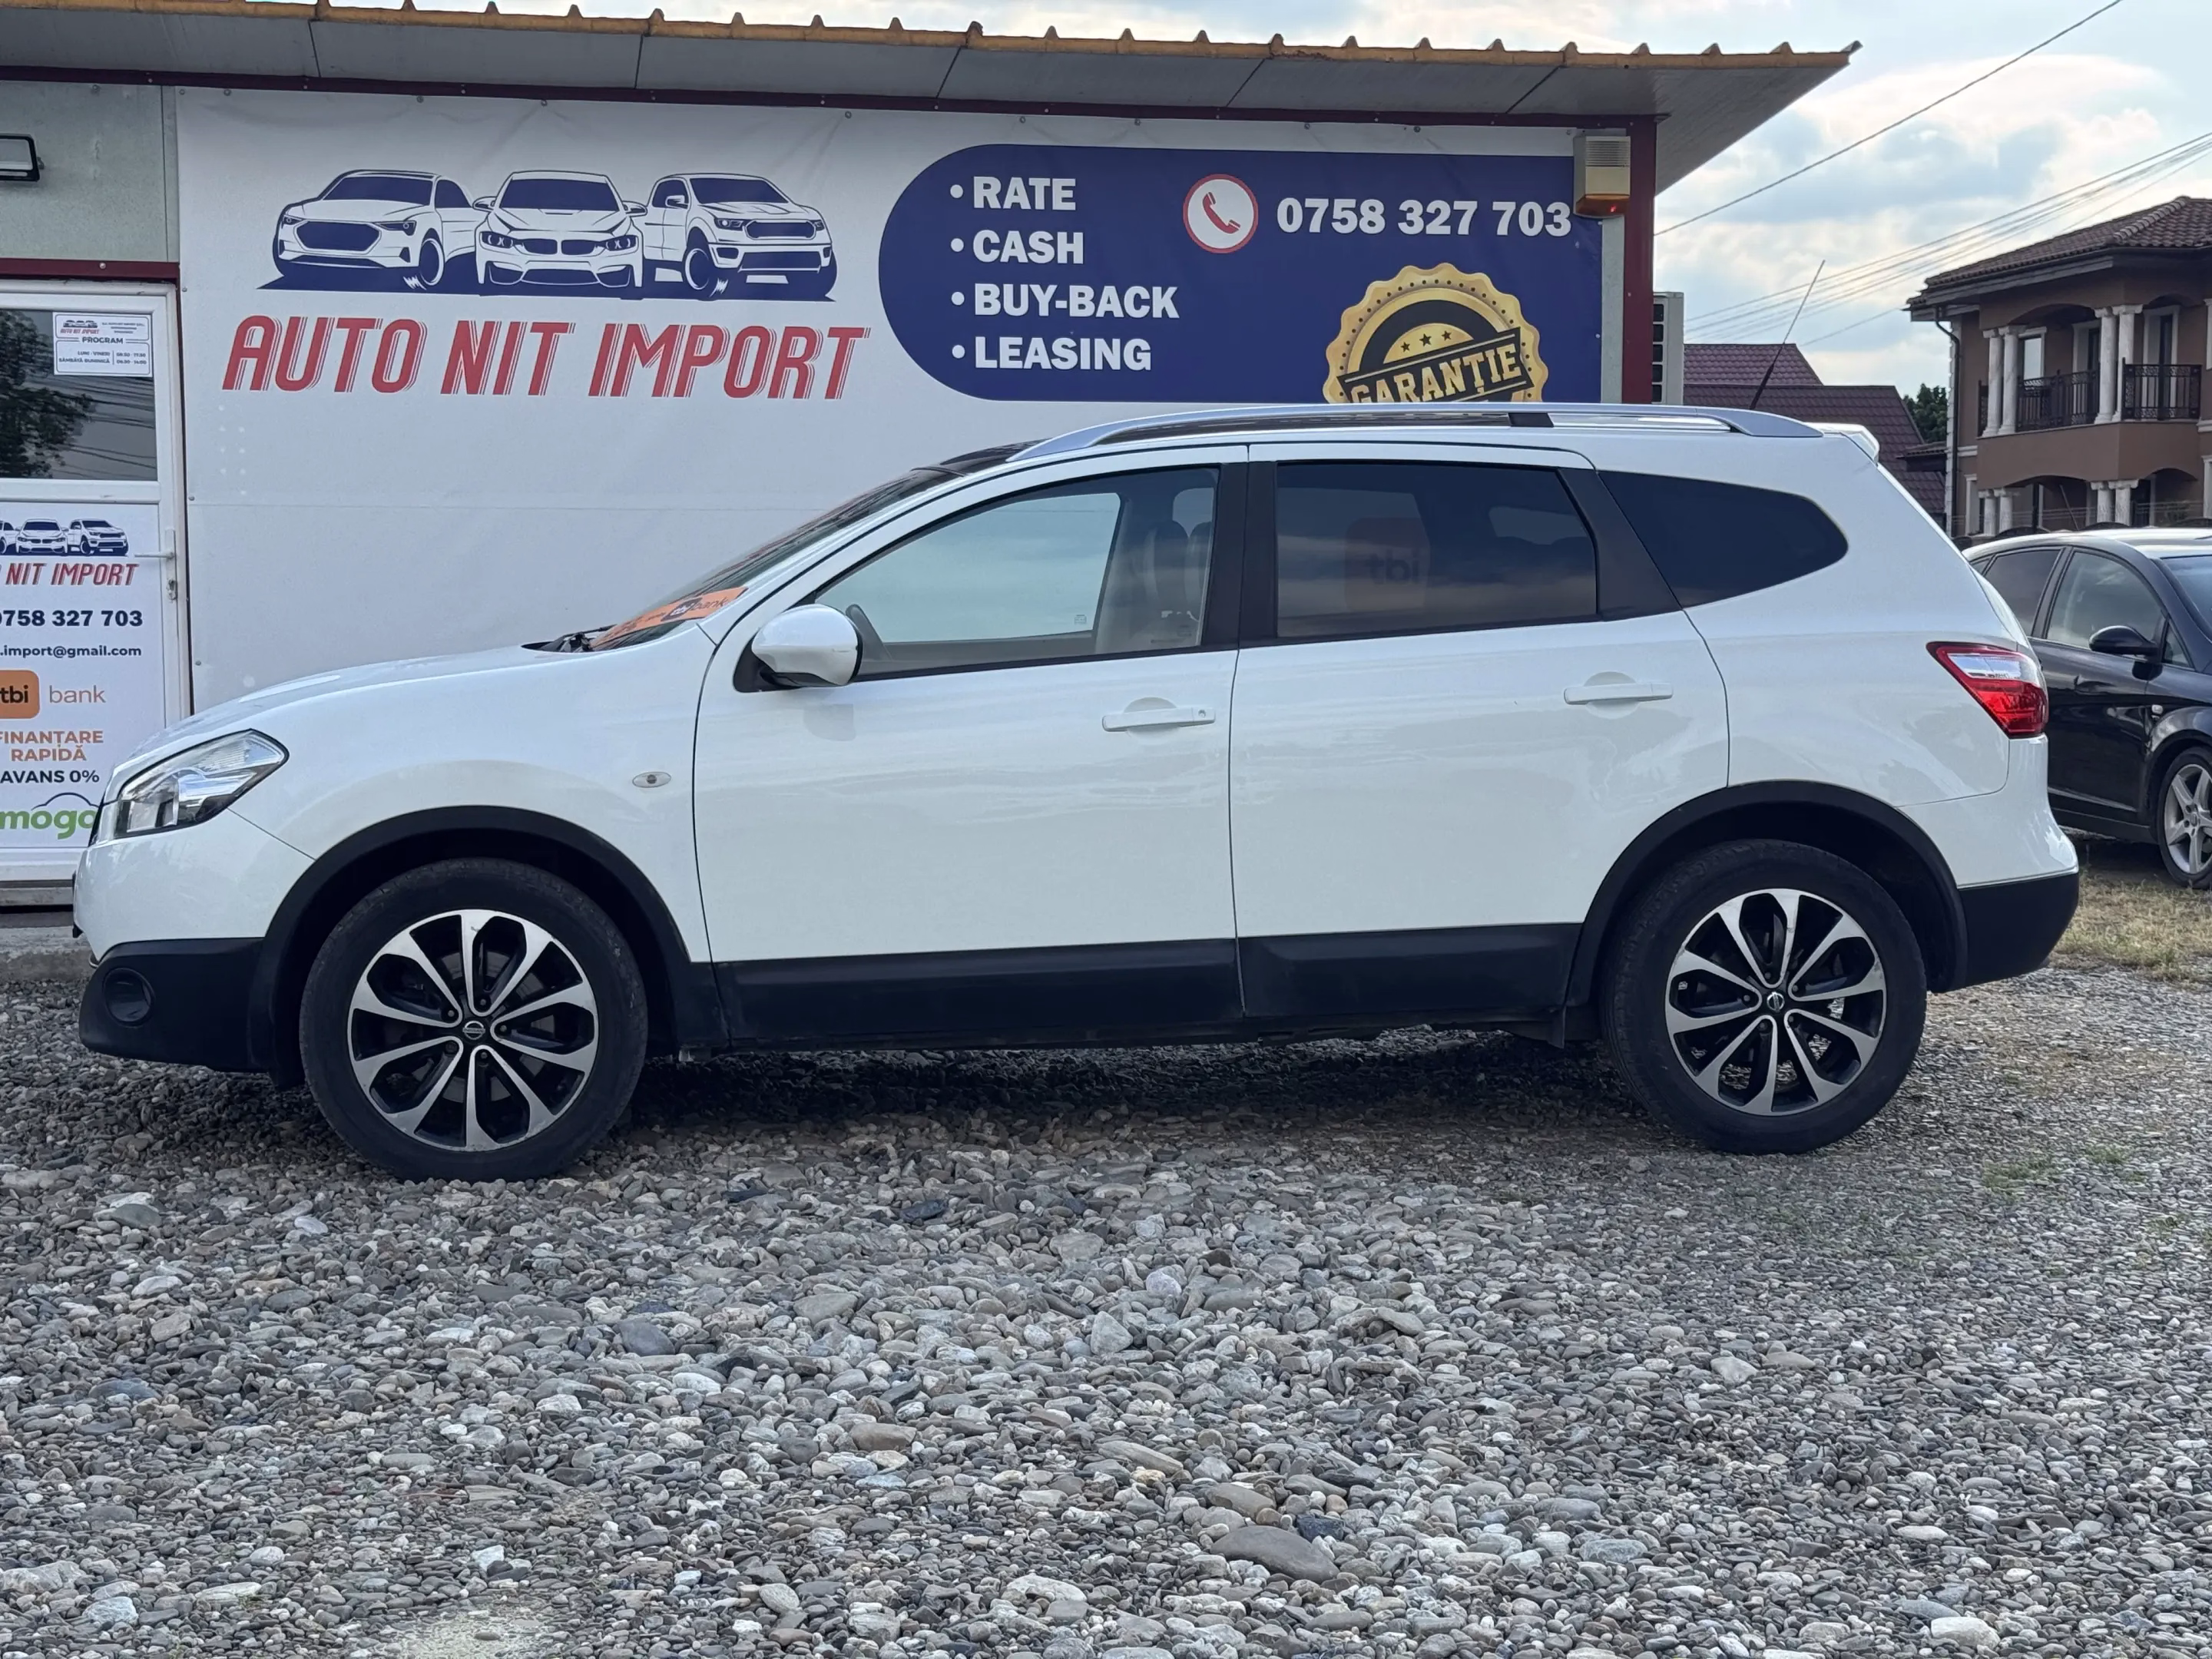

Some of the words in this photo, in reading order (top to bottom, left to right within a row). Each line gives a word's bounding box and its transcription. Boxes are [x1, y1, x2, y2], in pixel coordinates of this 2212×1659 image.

[973, 176, 1076, 211] RATE
[1277, 197, 1386, 234] 0758
[1398, 199, 1478, 235] 327
[1492, 201, 1571, 237] 703
[972, 229, 1084, 264] CASH
[974, 283, 1180, 319] BUY-BACK
[222, 314, 428, 393] AUTO
[440, 320, 575, 396] NIT
[588, 323, 871, 400] IMPORT
[975, 336, 1151, 371] LEASING
[5, 562, 47, 585] NIT
[51, 563, 140, 586] IMPORT
[0, 610, 45, 627] 758
[51, 610, 94, 627] 327
[101, 610, 143, 627] 703
[1, 684, 28, 704] tbi
[49, 685, 106, 704] bank
[11, 744, 87, 762] RAPIDĂ
[1, 770, 65, 783] AVANS
[69, 770, 100, 783] 0%
